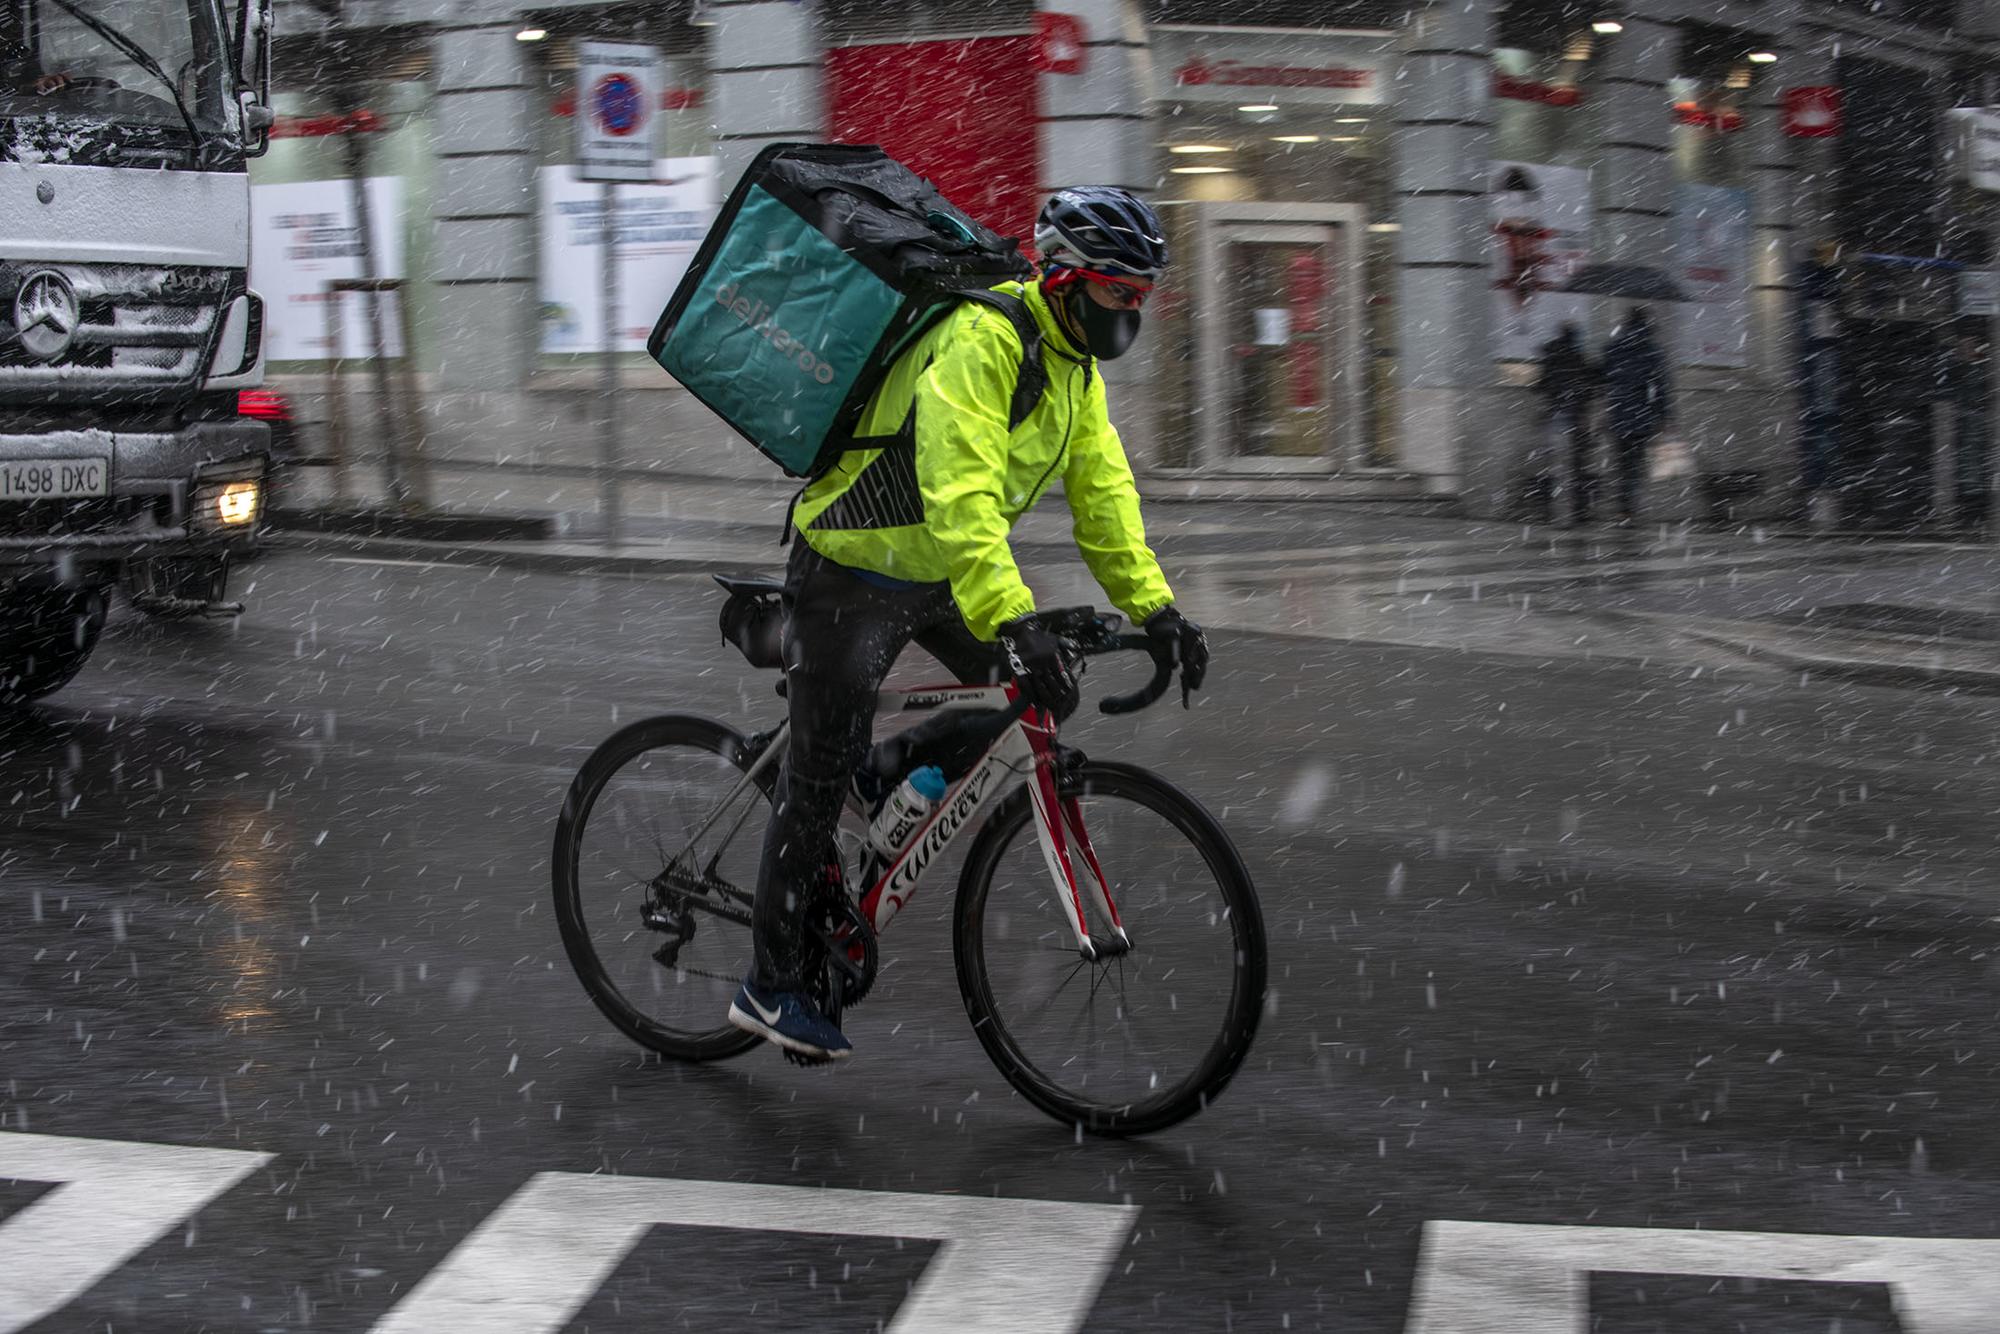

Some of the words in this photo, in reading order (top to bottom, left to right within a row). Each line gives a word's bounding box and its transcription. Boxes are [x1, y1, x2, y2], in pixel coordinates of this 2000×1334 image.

[4, 466, 53, 495] 1498
[62, 465, 98, 493] DXC
[890, 768, 991, 891] Wilier
